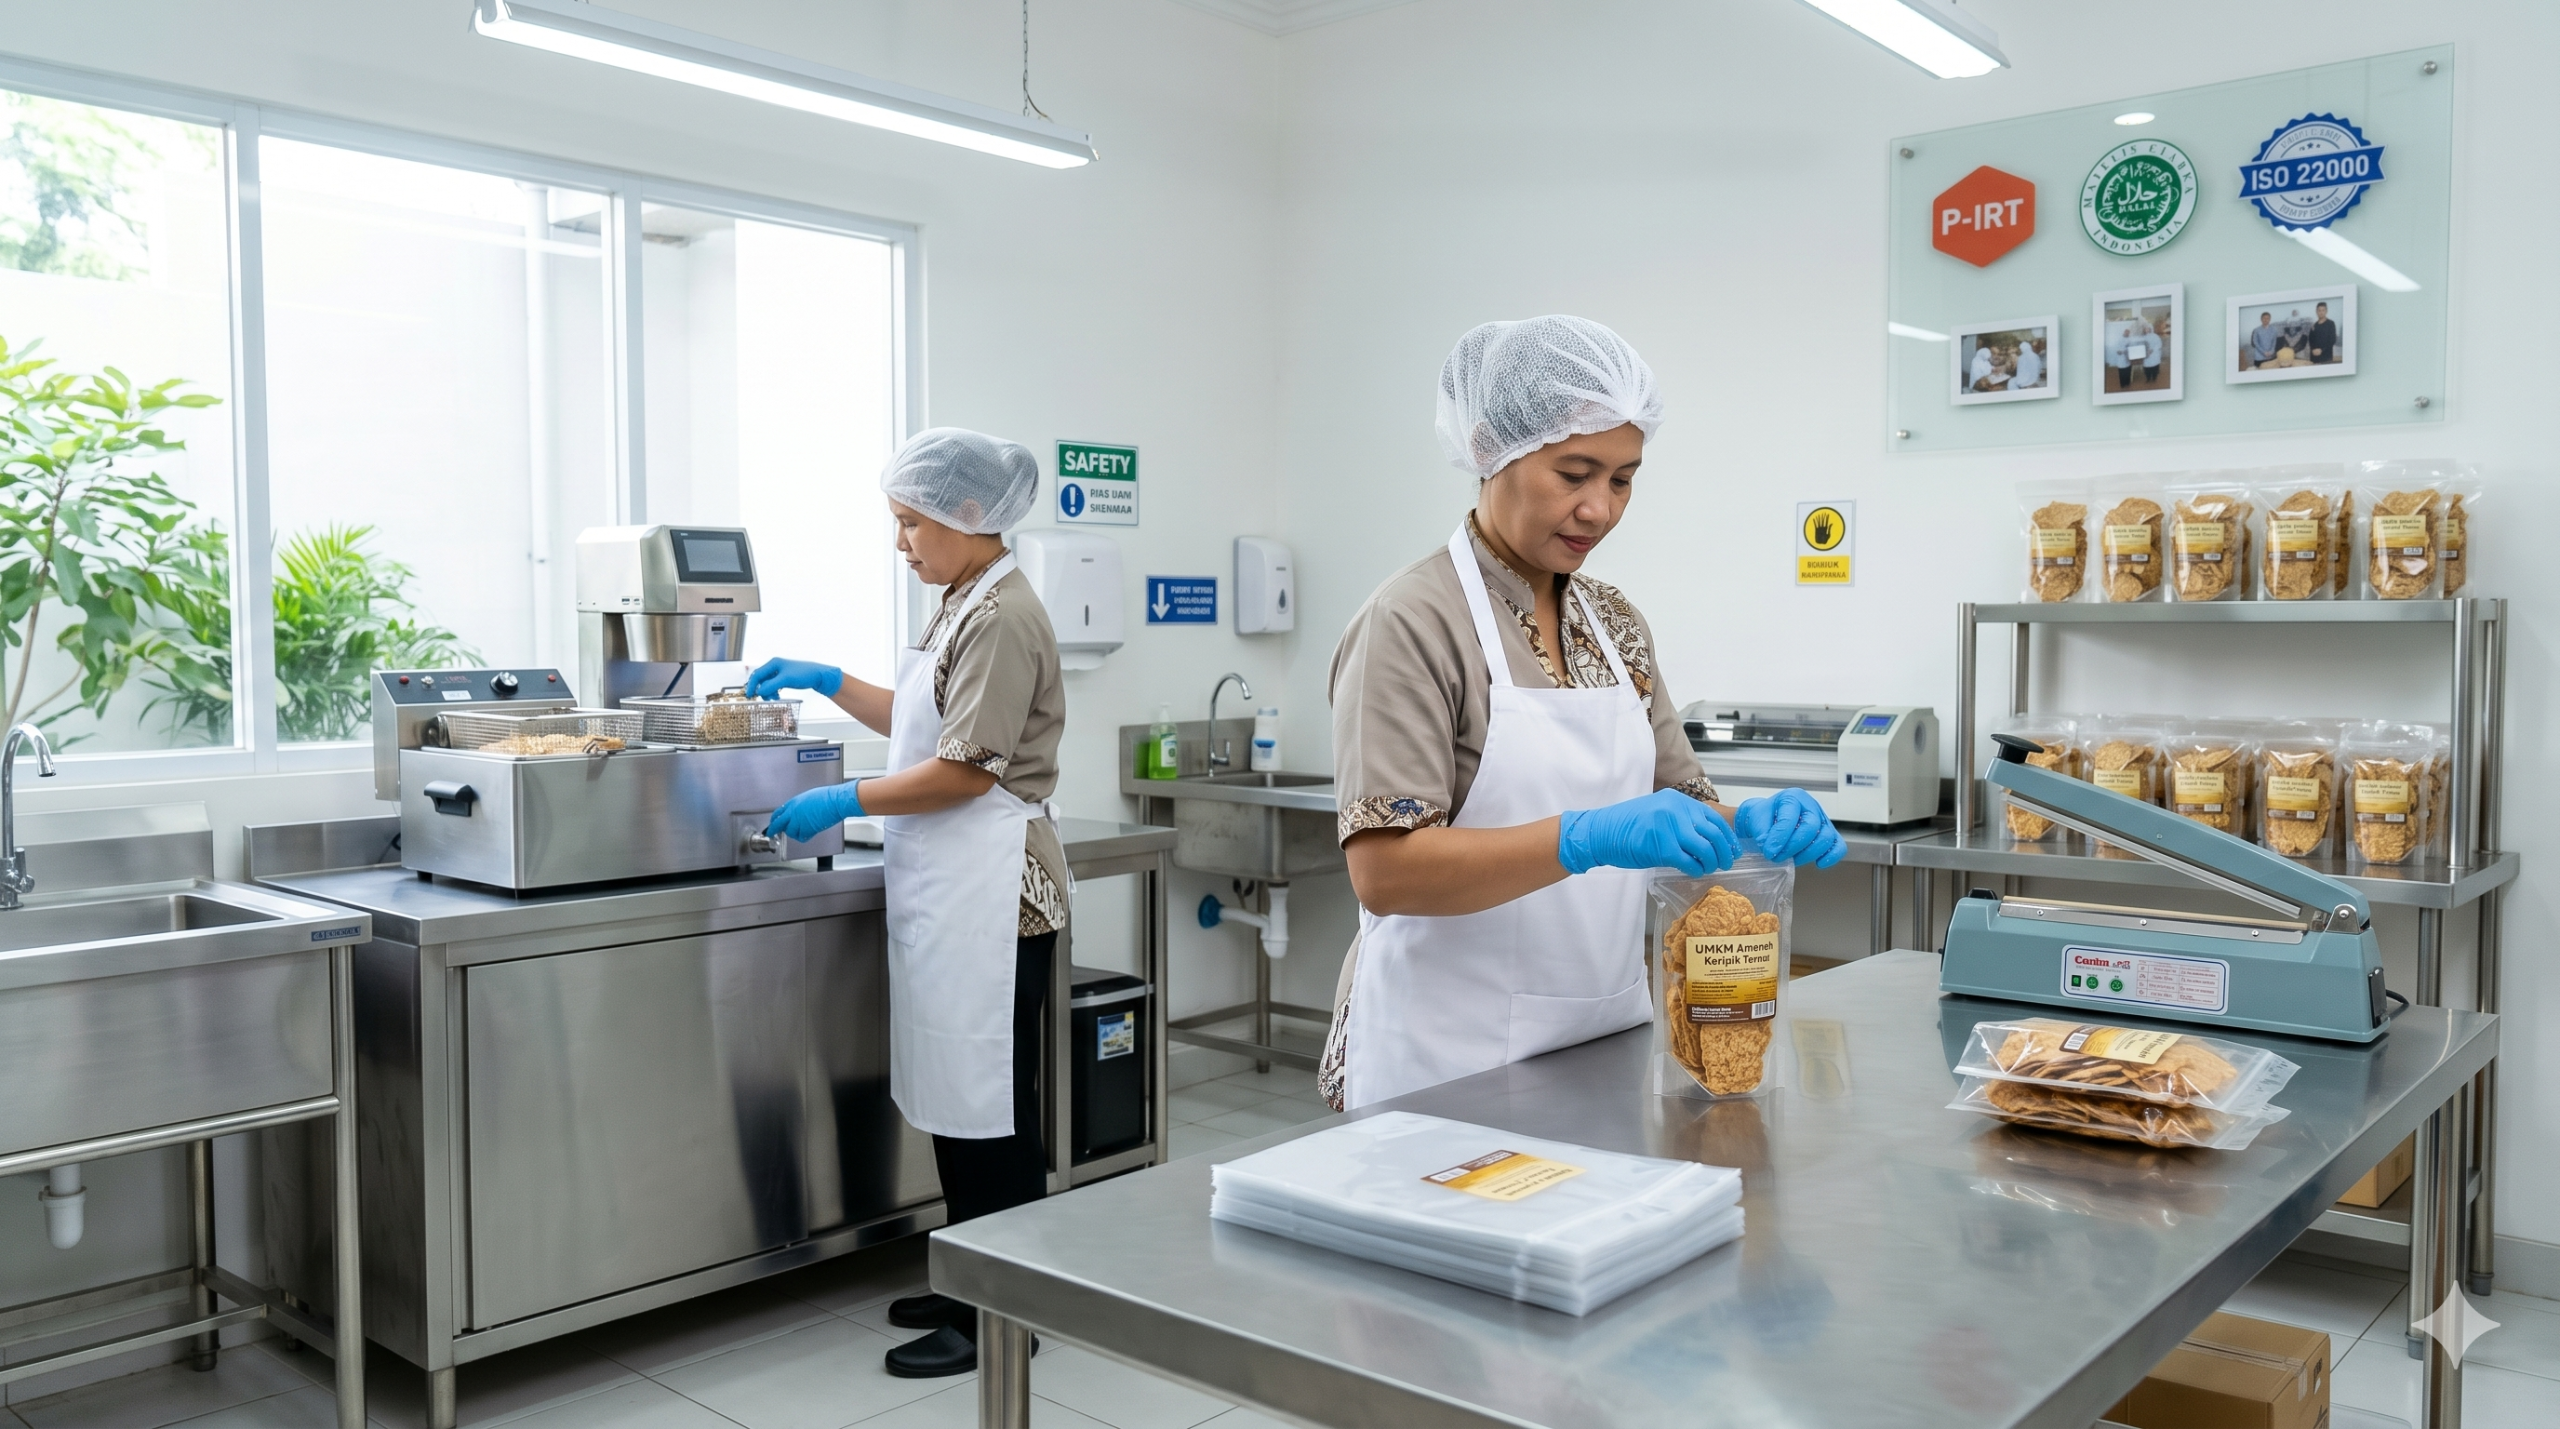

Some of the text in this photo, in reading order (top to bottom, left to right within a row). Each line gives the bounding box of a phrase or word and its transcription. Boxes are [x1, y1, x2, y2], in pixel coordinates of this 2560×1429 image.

[2251, 154, 2370, 191] ISO 22000
[1941, 197, 2025, 236] P-IRT
[2093, 219, 2183, 252] INDONESIA
[1064, 450, 1131, 475] SAFETY
[1695, 941, 1773, 954] UMKM Ameneh
[1704, 955, 1741, 967] Keripik
